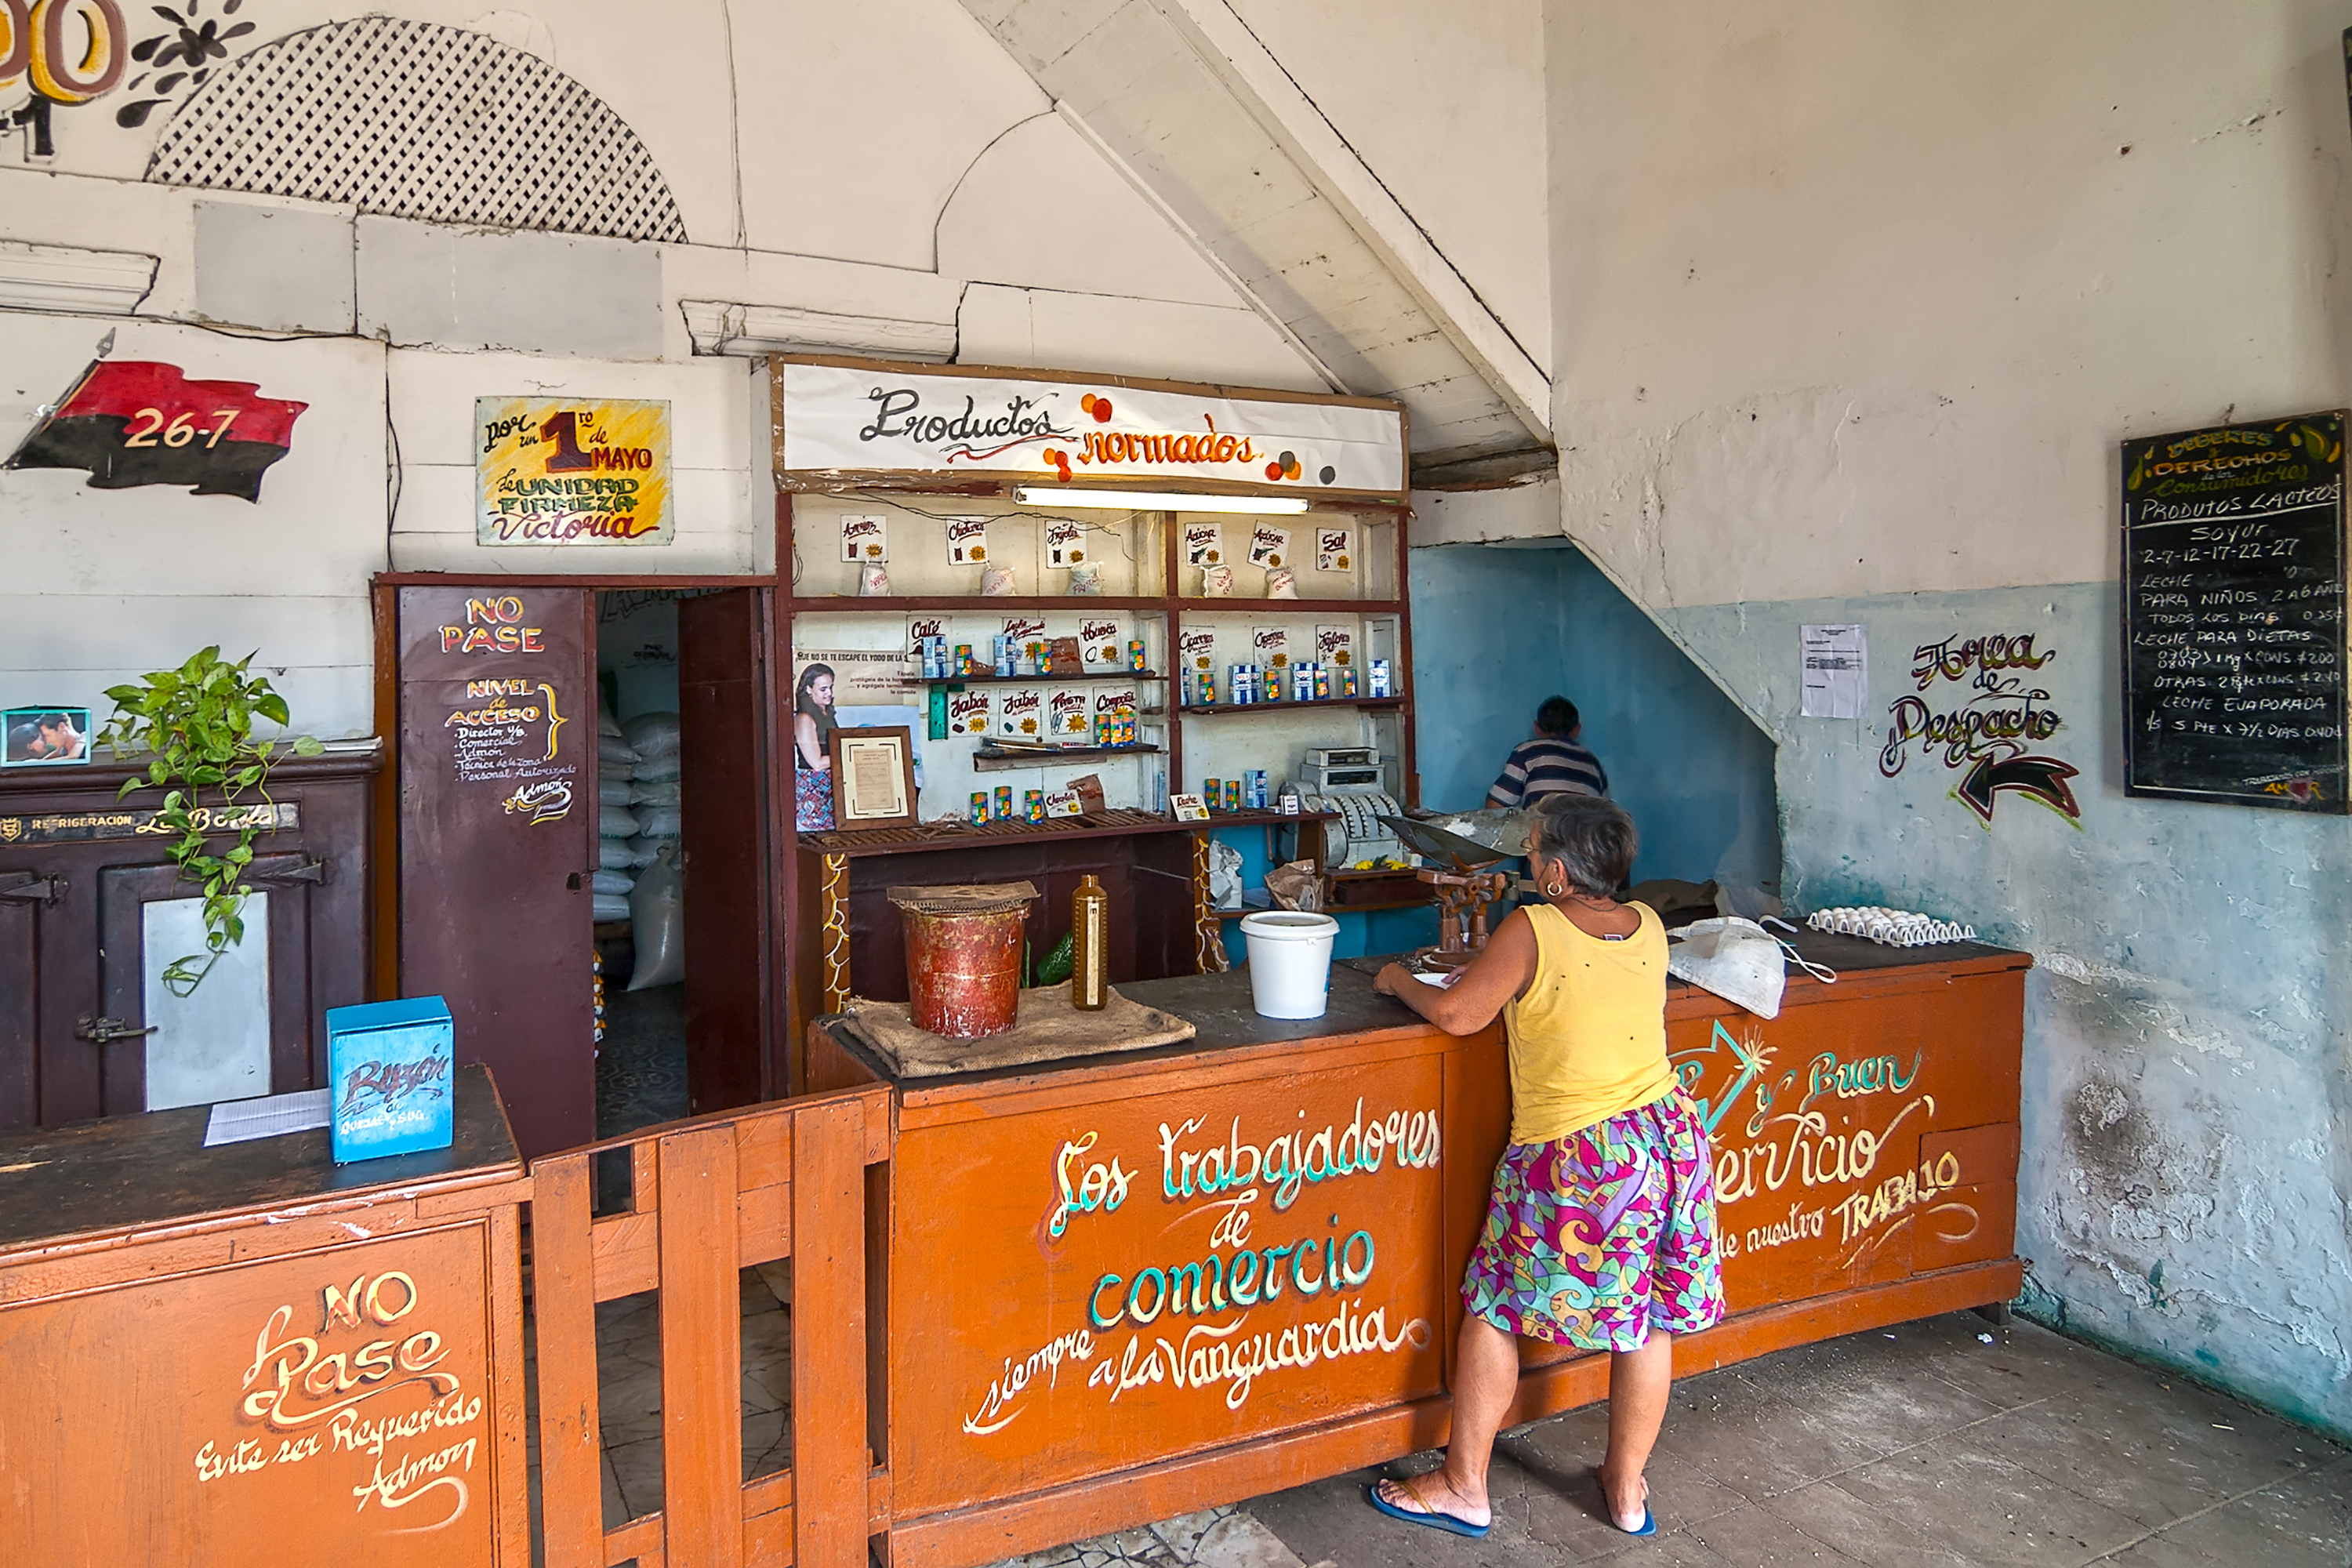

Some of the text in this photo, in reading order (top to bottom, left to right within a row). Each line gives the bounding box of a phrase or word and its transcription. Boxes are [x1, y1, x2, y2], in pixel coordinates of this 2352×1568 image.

[124, 407, 241, 448] 26-7
[484, 414, 536, 453] por
[589, 426, 608, 444] de
[858, 387, 1259, 465] Productos normados
[519, 433, 539, 448] un
[2166, 430, 2274, 460] DEBERES
[592, 447, 653, 470] MAYO
[2153, 448, 2292, 477] DERECHOS
[516, 477, 640, 496] UNIDAD
[2147, 464, 2310, 497] Consumidores
[498, 495, 639, 514] FIRMEZA
[1322, 532, 1347, 548] Sal
[2140, 574, 2194, 588] LECHE
[2139, 593, 2189, 607] PARA
[2201, 590, 2258, 605] NIÑOS
[2271, 590, 2285, 602] 2
[2287, 590, 2299, 601] A
[2300, 583, 2312, 597] 6
[465, 596, 524, 625] NO
[2147, 612, 2194, 625] TODOS
[2201, 612, 2230, 623] LOS
[2238, 612, 2280, 622] DIAS
[438, 625, 545, 654] PASE
[911, 619, 942, 640] Café
[2134, 628, 2312, 647] LECHE PARA DIETAS
[820, 653, 829, 662] SE
[829, 653, 837, 662] TE
[837, 653, 862, 662] ESCAPE
[862, 654, 869, 662] EL
[887, 654, 895, 662] DE
[895, 654, 903, 662] LA
[466, 679, 535, 699] NIVEL
[1972, 670, 2010, 692] de
[2154, 675, 2207, 689] OTRAS
[488, 696, 508, 710] de
[950, 691, 989, 718] Jabón
[1003, 690, 1040, 714] Jabón
[2162, 695, 2328, 713] LECHE EVAPORADA
[445, 706, 542, 728] ACCESO
[1880, 689, 2063, 775] Despacho
[2267, 723, 2301, 739] DIAS
[459, 737, 523, 750] Comercial
[458, 764, 577, 782] Personal Autorizado
[1797, 1046, 1922, 1115] Buen
[1708, 1109, 1905, 1205] ervicio
[1039, 1130, 1138, 1247] Los
[1207, 1192, 1258, 1250] de
[1746, 1200, 1828, 1254] nuestro
[1087, 1214, 1376, 1331] comercio
[316, 1270, 418, 1337] NO
[1087, 1297, 1419, 1411] a la Vanguardia
[240, 1314, 458, 1428] Pase
[967, 1325, 1097, 1432] siempre
[194, 1392, 482, 1483] Evite ser Requerido
